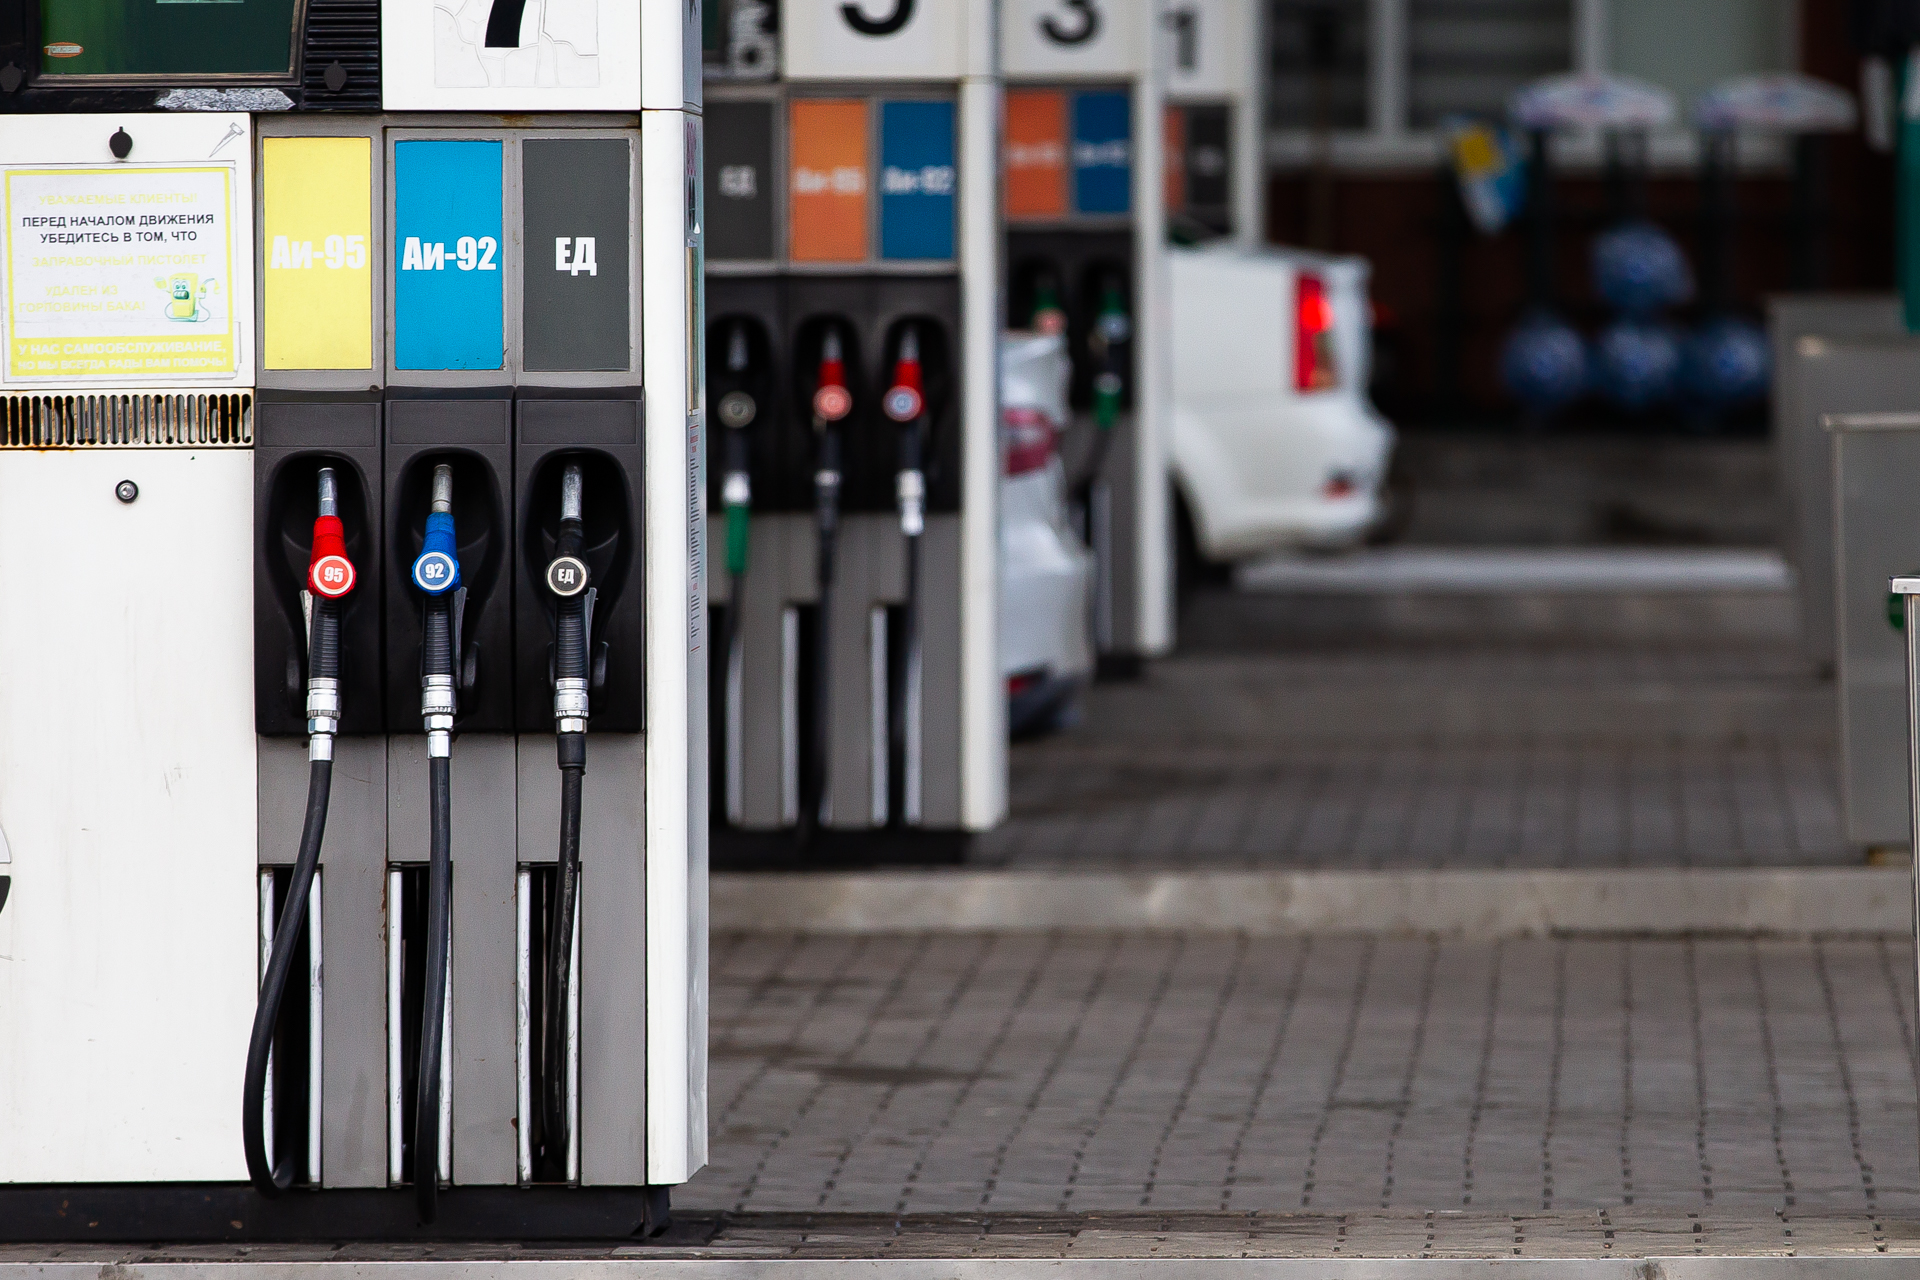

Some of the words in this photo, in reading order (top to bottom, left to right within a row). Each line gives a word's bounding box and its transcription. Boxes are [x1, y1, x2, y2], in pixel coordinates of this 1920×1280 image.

[38, 194, 126, 206] УВАЖАЕМЫЕ
[130, 193, 198, 204] КЛИЕНТЫ!
[22, 217, 66, 228] ПЕРЕД
[70, 216, 135, 226] НАЧАЛОМ
[139, 214, 214, 227] ДВИЖЕНИЯ
[40, 232, 119, 244] УБЕДИТЕСЬ
[123, 232, 132, 242] В
[136, 231, 167, 243] ТОМ,
[171, 231, 197, 241] ЧТО
[270, 235, 366, 269] Аи-95
[402, 236, 497, 270] Аи-92
[555, 237, 597, 276] ЕД
[32, 254, 134, 267] ЗАПРАВОЧНЫЙ
[138, 254, 207, 265] ПИСТОЛЕТ
[45, 286, 97, 298] УДАЛЕН
[101, 285, 118, 295] ИЗ
[19, 302, 103, 313] ГОРЛОВИНЫ
[107, 301, 145, 312] БАКА!
[18, 344, 28, 356] У
[31, 344, 61, 355] НАС
[64, 341, 226, 355] САМООБСЛУЖИВАНИЕ,
[18, 361, 35, 370] НО
[38, 361, 58, 370] МЫ
[61, 360, 106, 370] ВСЕГДА
[109, 359, 142, 370] РАДЫ
[146, 358, 170, 368] ВАМ
[173, 358, 227, 367] ПОМОЧЬ!
[324, 567, 344, 582] 95
[425, 563, 444, 578] 92
[557, 568, 574, 584] ЕД
